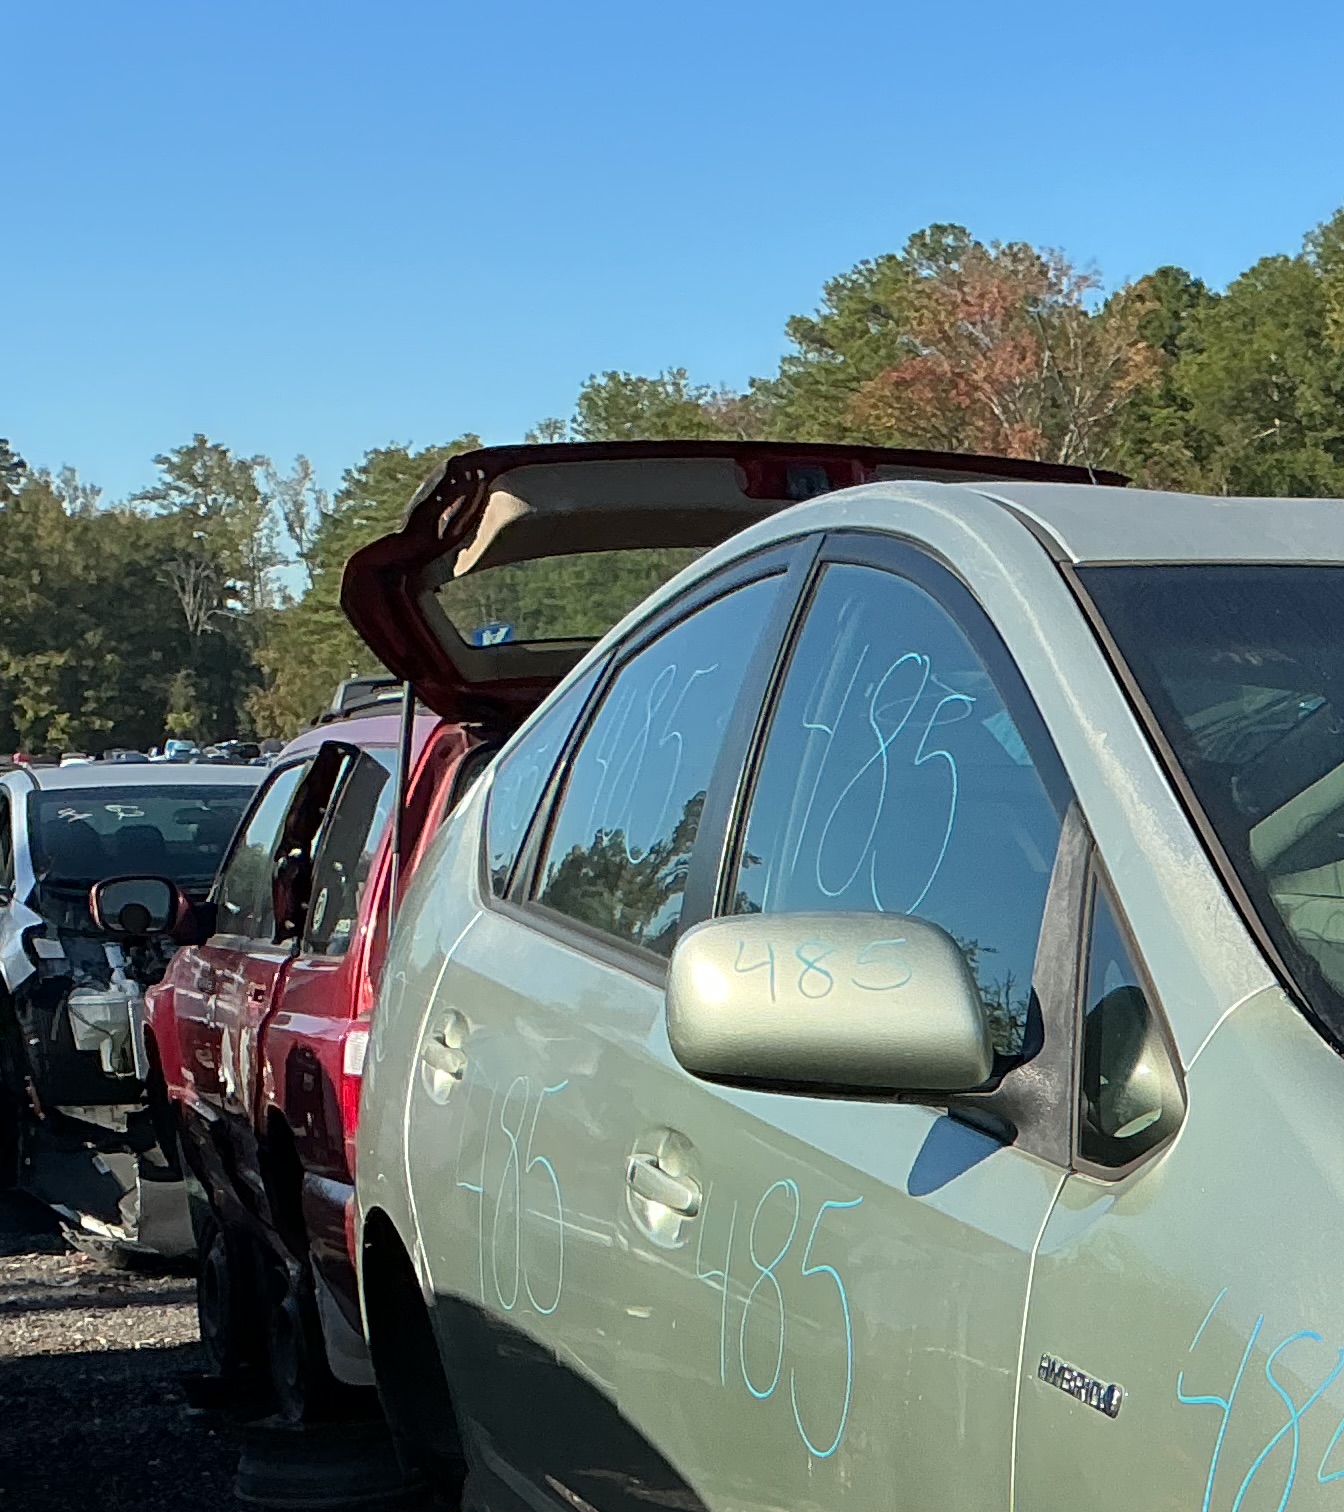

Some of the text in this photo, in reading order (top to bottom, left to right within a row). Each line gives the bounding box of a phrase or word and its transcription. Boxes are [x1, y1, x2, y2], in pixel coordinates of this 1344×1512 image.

[584, 664, 719, 864] 485
[790, 643, 977, 915] 485
[734, 938, 912, 1004] 485
[456, 1070, 569, 1315] 485
[696, 1178, 863, 1458] 485
